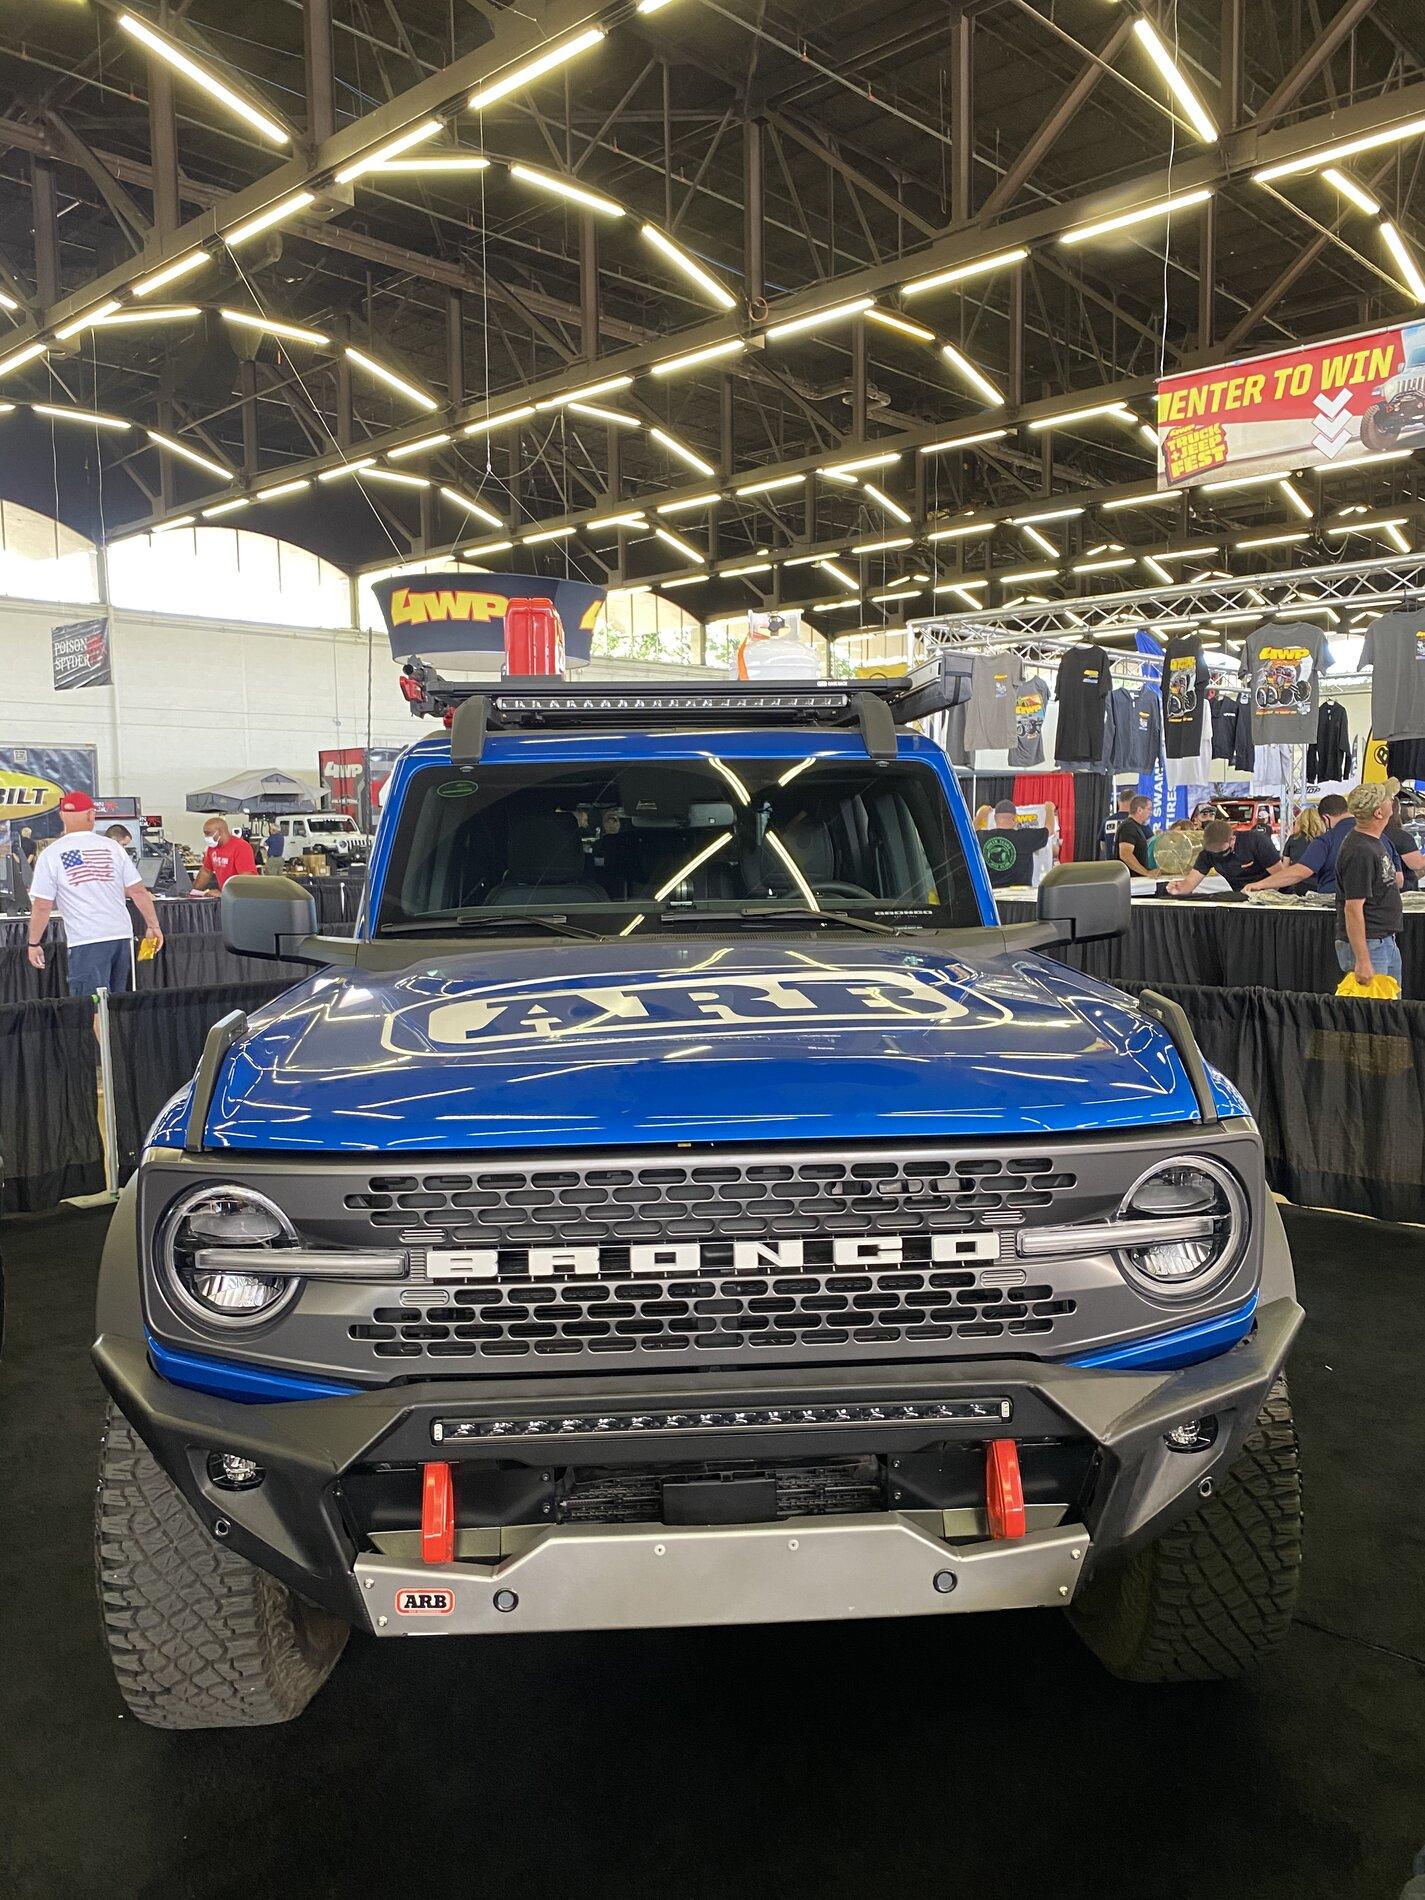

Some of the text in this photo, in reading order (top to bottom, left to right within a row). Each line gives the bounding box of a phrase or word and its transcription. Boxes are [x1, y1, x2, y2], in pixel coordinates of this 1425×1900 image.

[1274, 363, 1314, 400] TO
[1321, 345, 1394, 390] WIN
[1167, 423, 1221, 451] TRUCK
[1171, 444, 1226, 478] FEST
[54, 637, 88, 656] POISON
[55, 654, 91, 671] SPYDER
[465, 979, 948, 1039] ARB
[427, 1232, 1000, 1278] BRONCO
[404, 1594, 447, 1609] ARB
